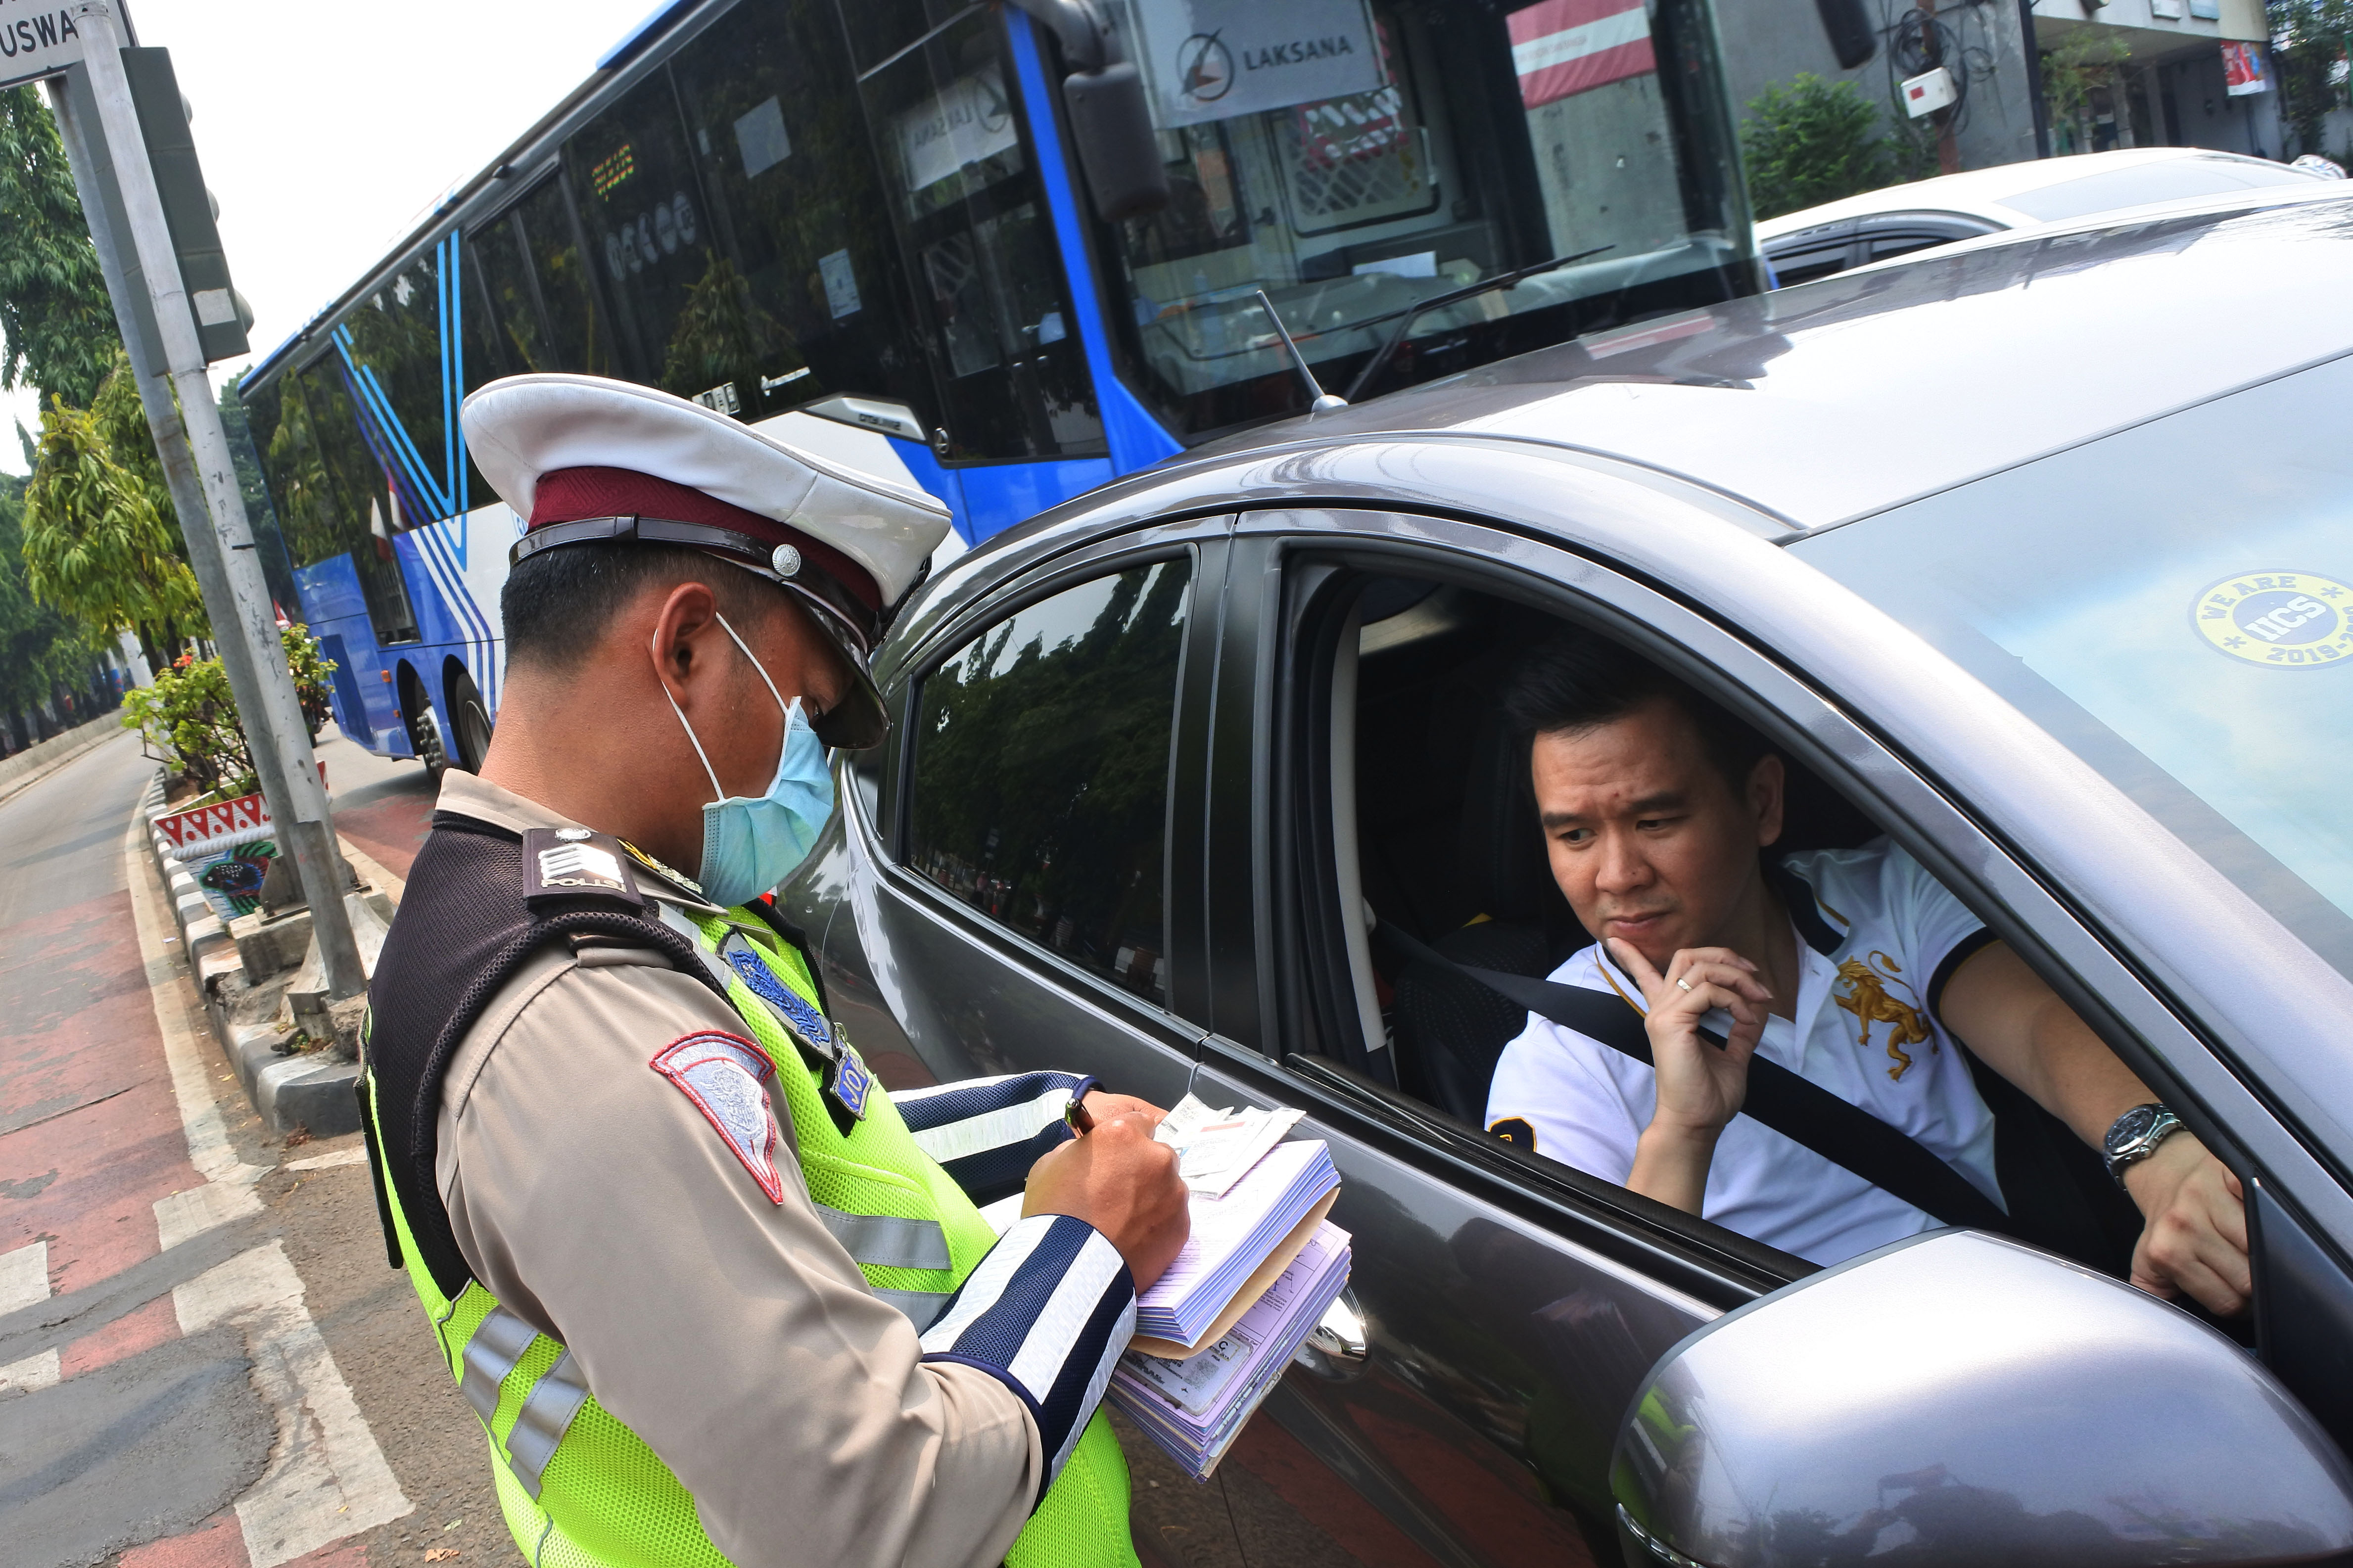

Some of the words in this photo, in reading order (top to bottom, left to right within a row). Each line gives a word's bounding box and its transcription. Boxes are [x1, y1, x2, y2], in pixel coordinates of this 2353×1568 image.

[1244, 36, 1353, 71] LAKSANA
[2202, 594, 2236, 619] WE
[2233, 576, 2296, 596] ARE
[541, 878, 627, 894] POLISI
